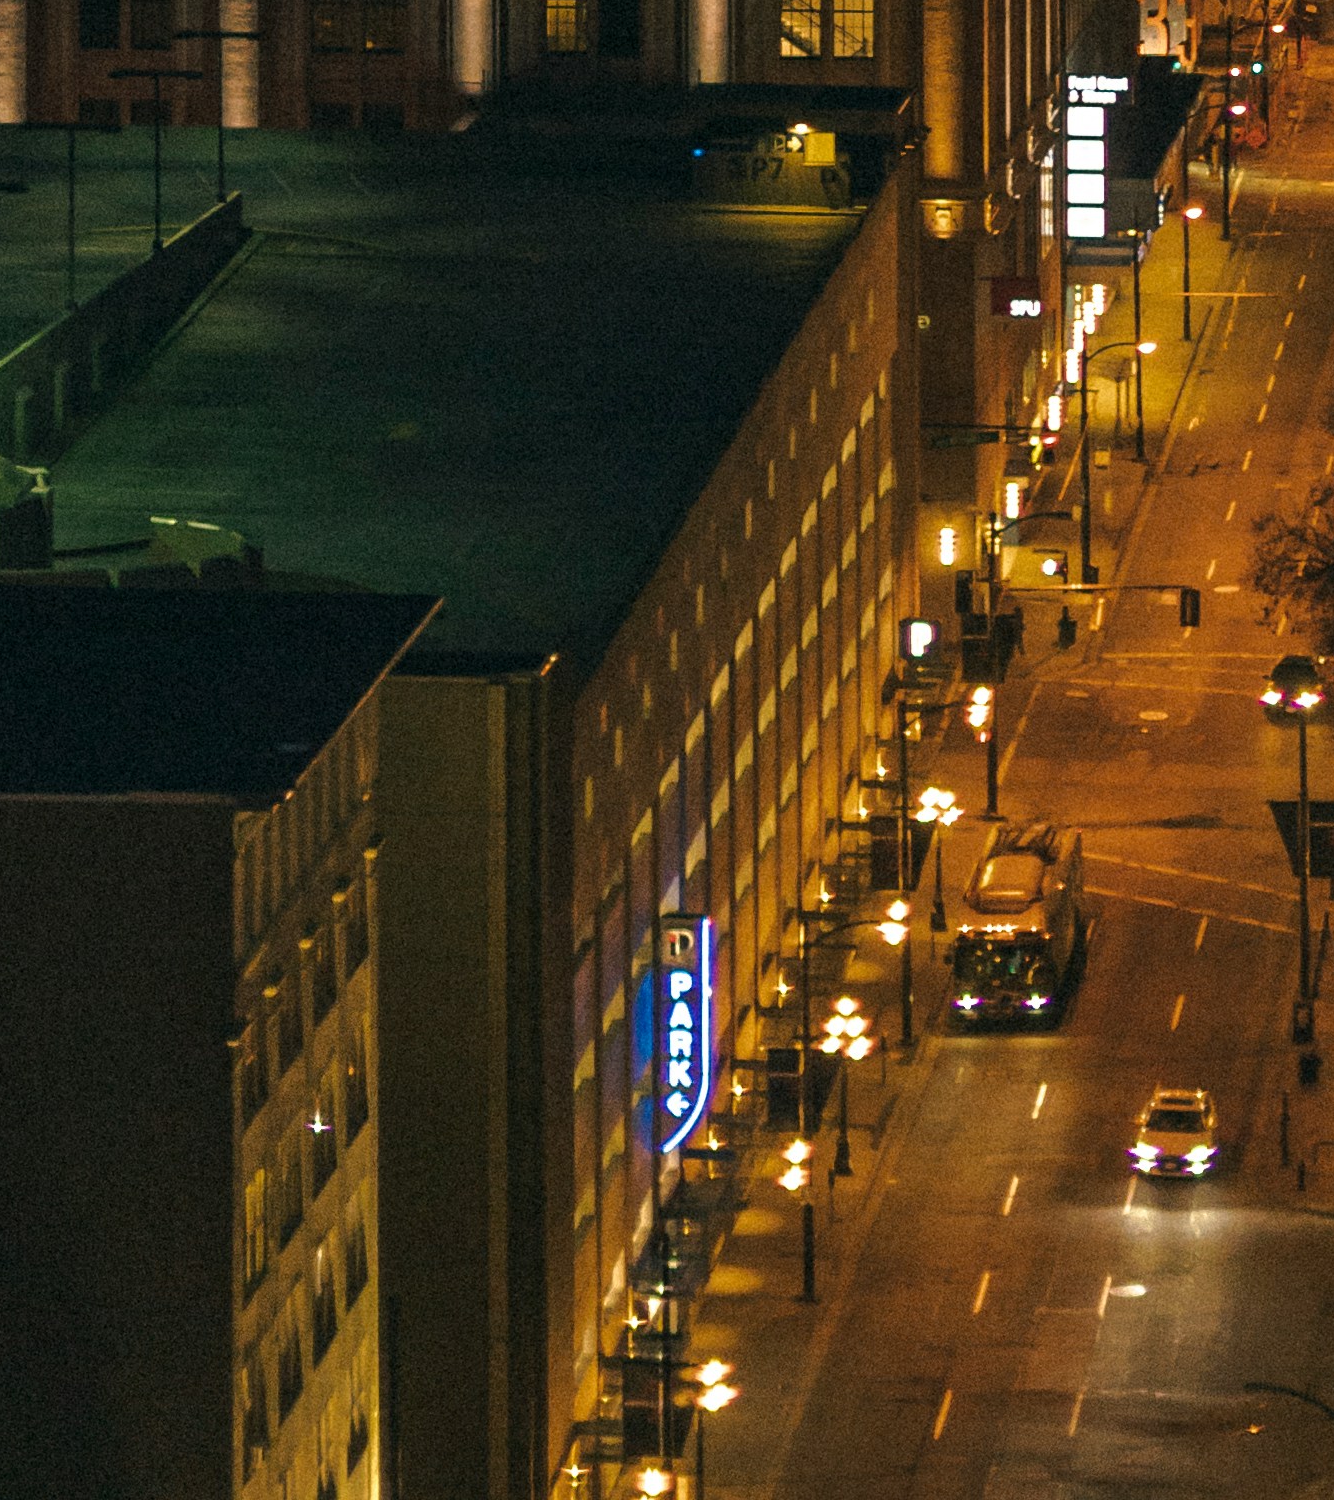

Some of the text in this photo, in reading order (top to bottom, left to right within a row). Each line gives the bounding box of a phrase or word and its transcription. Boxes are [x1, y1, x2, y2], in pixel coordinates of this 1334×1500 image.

[1010, 299, 1041, 317] SFU
[910, 622, 932, 657] P
[669, 971, 694, 1088] PARK
